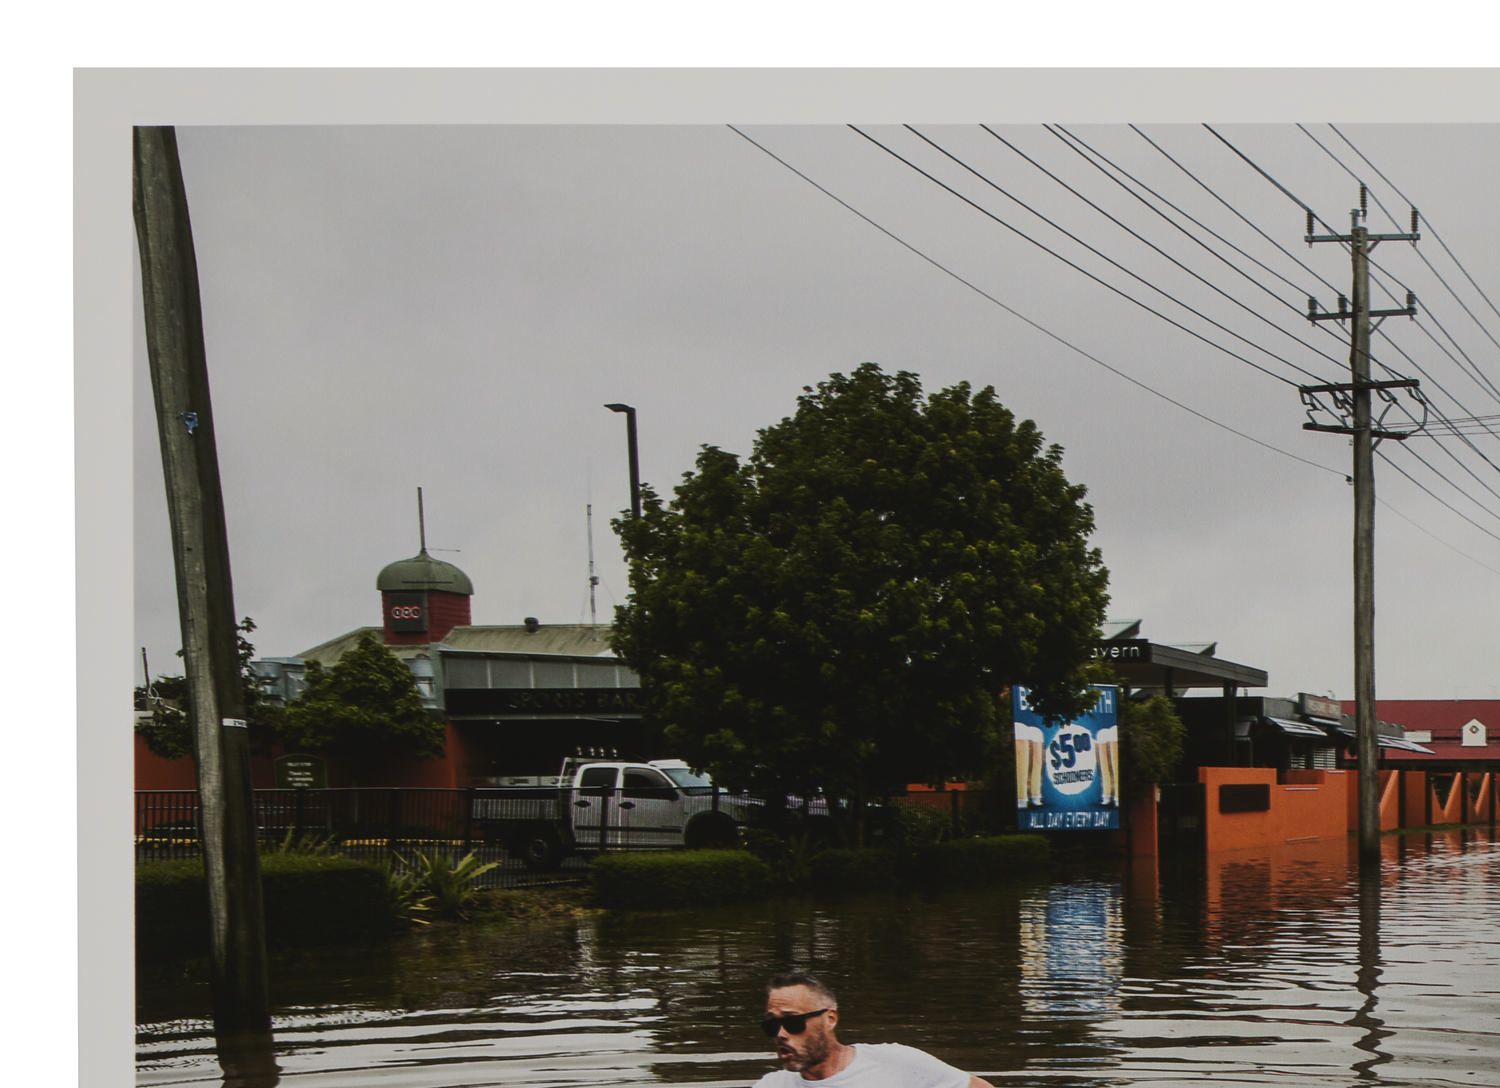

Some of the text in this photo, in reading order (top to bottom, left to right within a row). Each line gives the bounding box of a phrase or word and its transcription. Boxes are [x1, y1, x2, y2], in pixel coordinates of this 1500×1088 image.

[1089, 646, 1140, 658] avern
[1053, 769, 1094, 785] SCHOONERS
[1030, 811, 1111, 828] ALL DAY EVERY DAY
